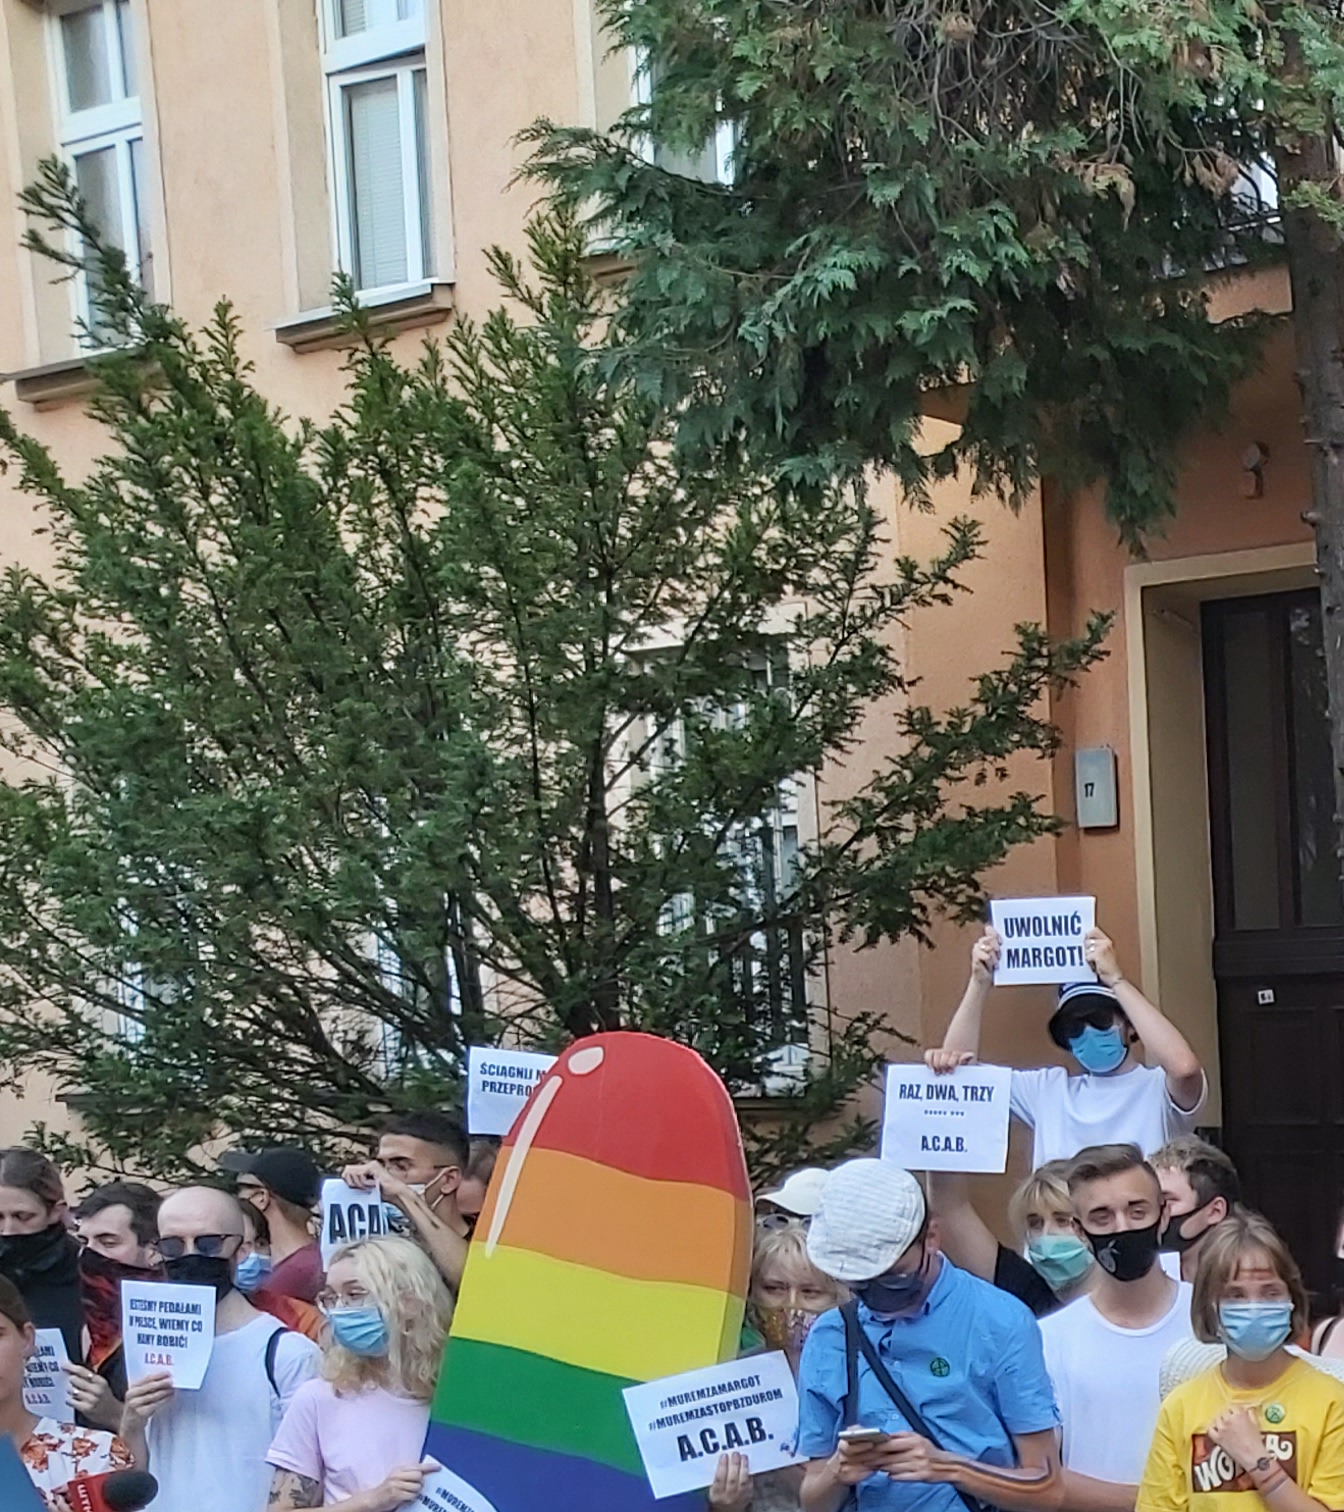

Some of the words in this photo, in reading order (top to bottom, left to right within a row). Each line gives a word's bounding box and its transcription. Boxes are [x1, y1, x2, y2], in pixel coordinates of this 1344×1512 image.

[1084, 782, 1095, 798] 17
[1003, 910, 1082, 939] UWOLNIĆ
[1006, 946, 1084, 969] MARGOT!
[480, 1061, 533, 1080] ŚCIĄGNIJ
[899, 1084, 923, 1101] RAZ,
[926, 1084, 959, 1102] DWA,
[962, 1085, 994, 1102] TRZY
[921, 1135, 968, 1153] A.C.A.B.
[328, 1203, 387, 1244] ACA
[191, 1320, 203, 1333] CO
[660, 1374, 761, 1410] #MUREMZAMARGOT
[677, 1417, 774, 1462] A.C.A.B.
